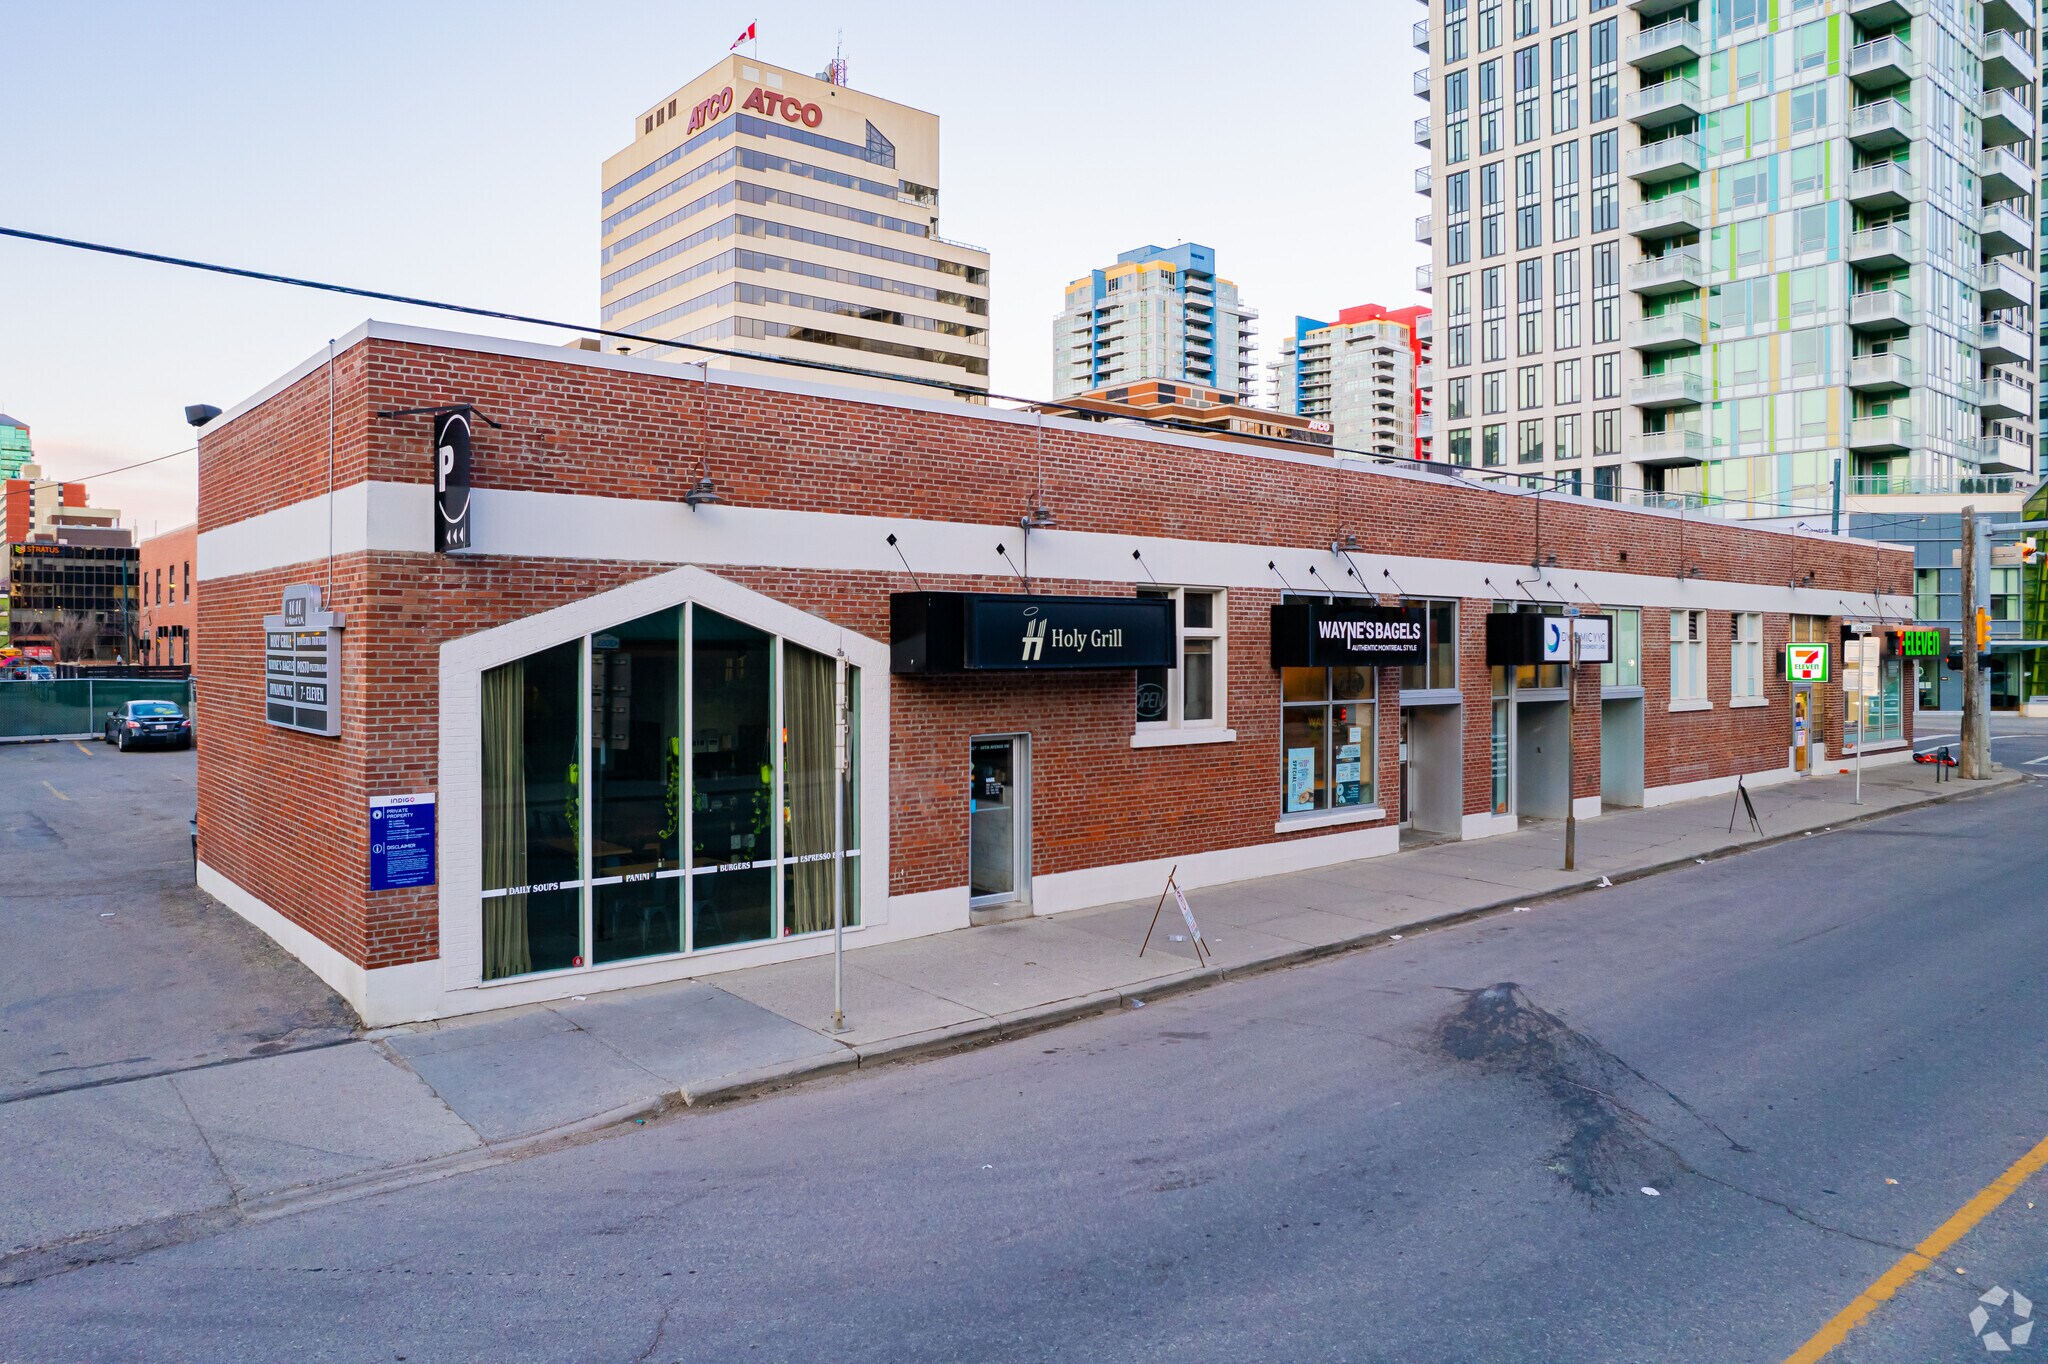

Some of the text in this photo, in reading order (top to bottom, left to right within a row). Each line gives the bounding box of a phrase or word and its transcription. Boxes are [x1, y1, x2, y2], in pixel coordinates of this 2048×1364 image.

[687, 86, 733, 135] ATCO
[742, 87, 823, 128] ATCO
[1308, 420, 1330, 432] ATCO
[439, 445, 454, 493] P
[27, 546, 60, 554] STRATUS
[270, 634, 292, 648] HOLY GRILL
[1052, 628, 1087, 652] Holy
[1091, 628, 1122, 648] Grill
[1319, 620, 1421, 649] WAYNE'S BAGELS
[306, 686, 324, 702] ELEVEN
[386, 843, 416, 851] DISCLAIMER
[800, 852, 831, 863] ESPRESSO
[719, 862, 751, 872] BURGERS
[625, 873, 650, 882] PANINI
[509, 882, 558, 896] DAILY SOUPS
